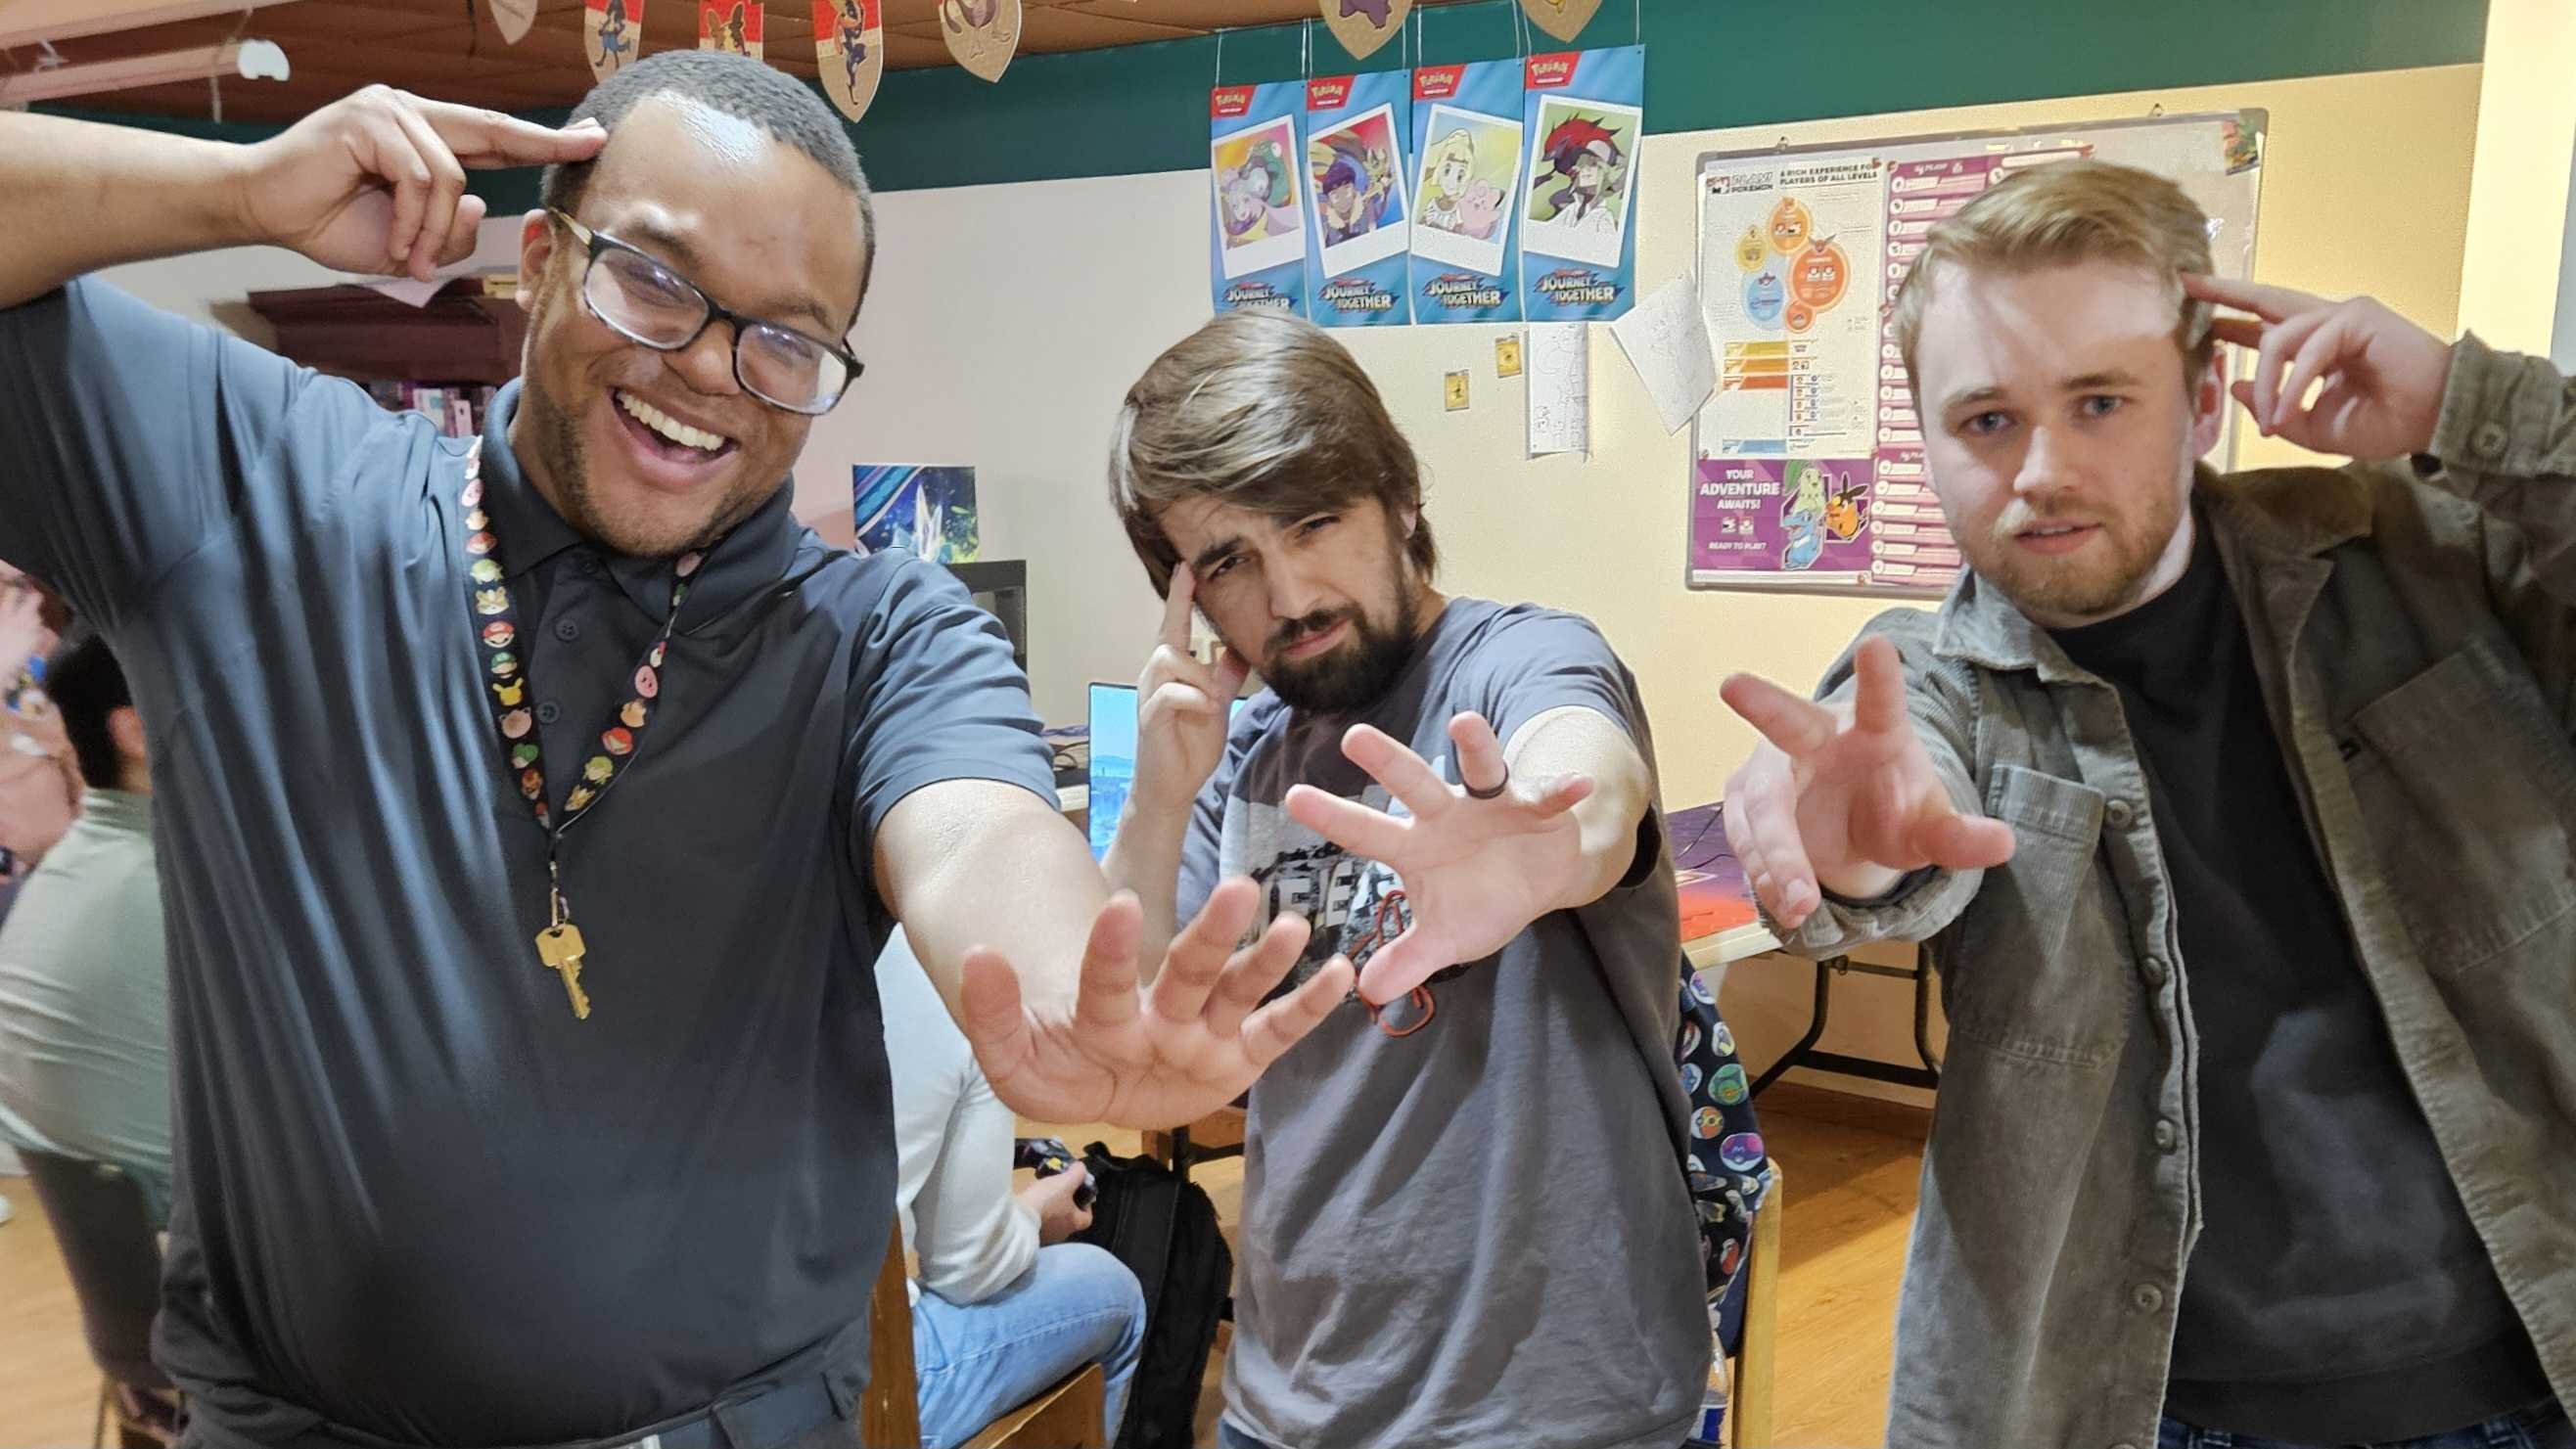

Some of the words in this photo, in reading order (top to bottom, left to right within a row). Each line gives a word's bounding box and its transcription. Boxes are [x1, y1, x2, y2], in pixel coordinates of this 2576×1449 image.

[1787, 166, 1807, 176] RICH
[1810, 162, 1858, 175] EXPERIENCE
[1779, 176, 1816, 185] PLAYERS
[1817, 174, 1828, 183] OF
[1830, 172, 1845, 182] ALL
[1847, 170, 1877, 180] LEVELS
[1429, 280, 1479, 295] JOURNEY
[1541, 276, 1590, 292] JOURNEY
[1227, 290, 1269, 301] JOURNEY
[1324, 285, 1369, 299] JOURNEY
[1443, 292, 1501, 306] TOGETHER
[1555, 287, 1614, 302] TOGETHER
[1338, 295, 1393, 310] TOGETHER
[1725, 470, 1754, 479] YOUR
[1700, 482, 1780, 495] ADVENTURE
[1717, 499, 1761, 510] AWAITS!
